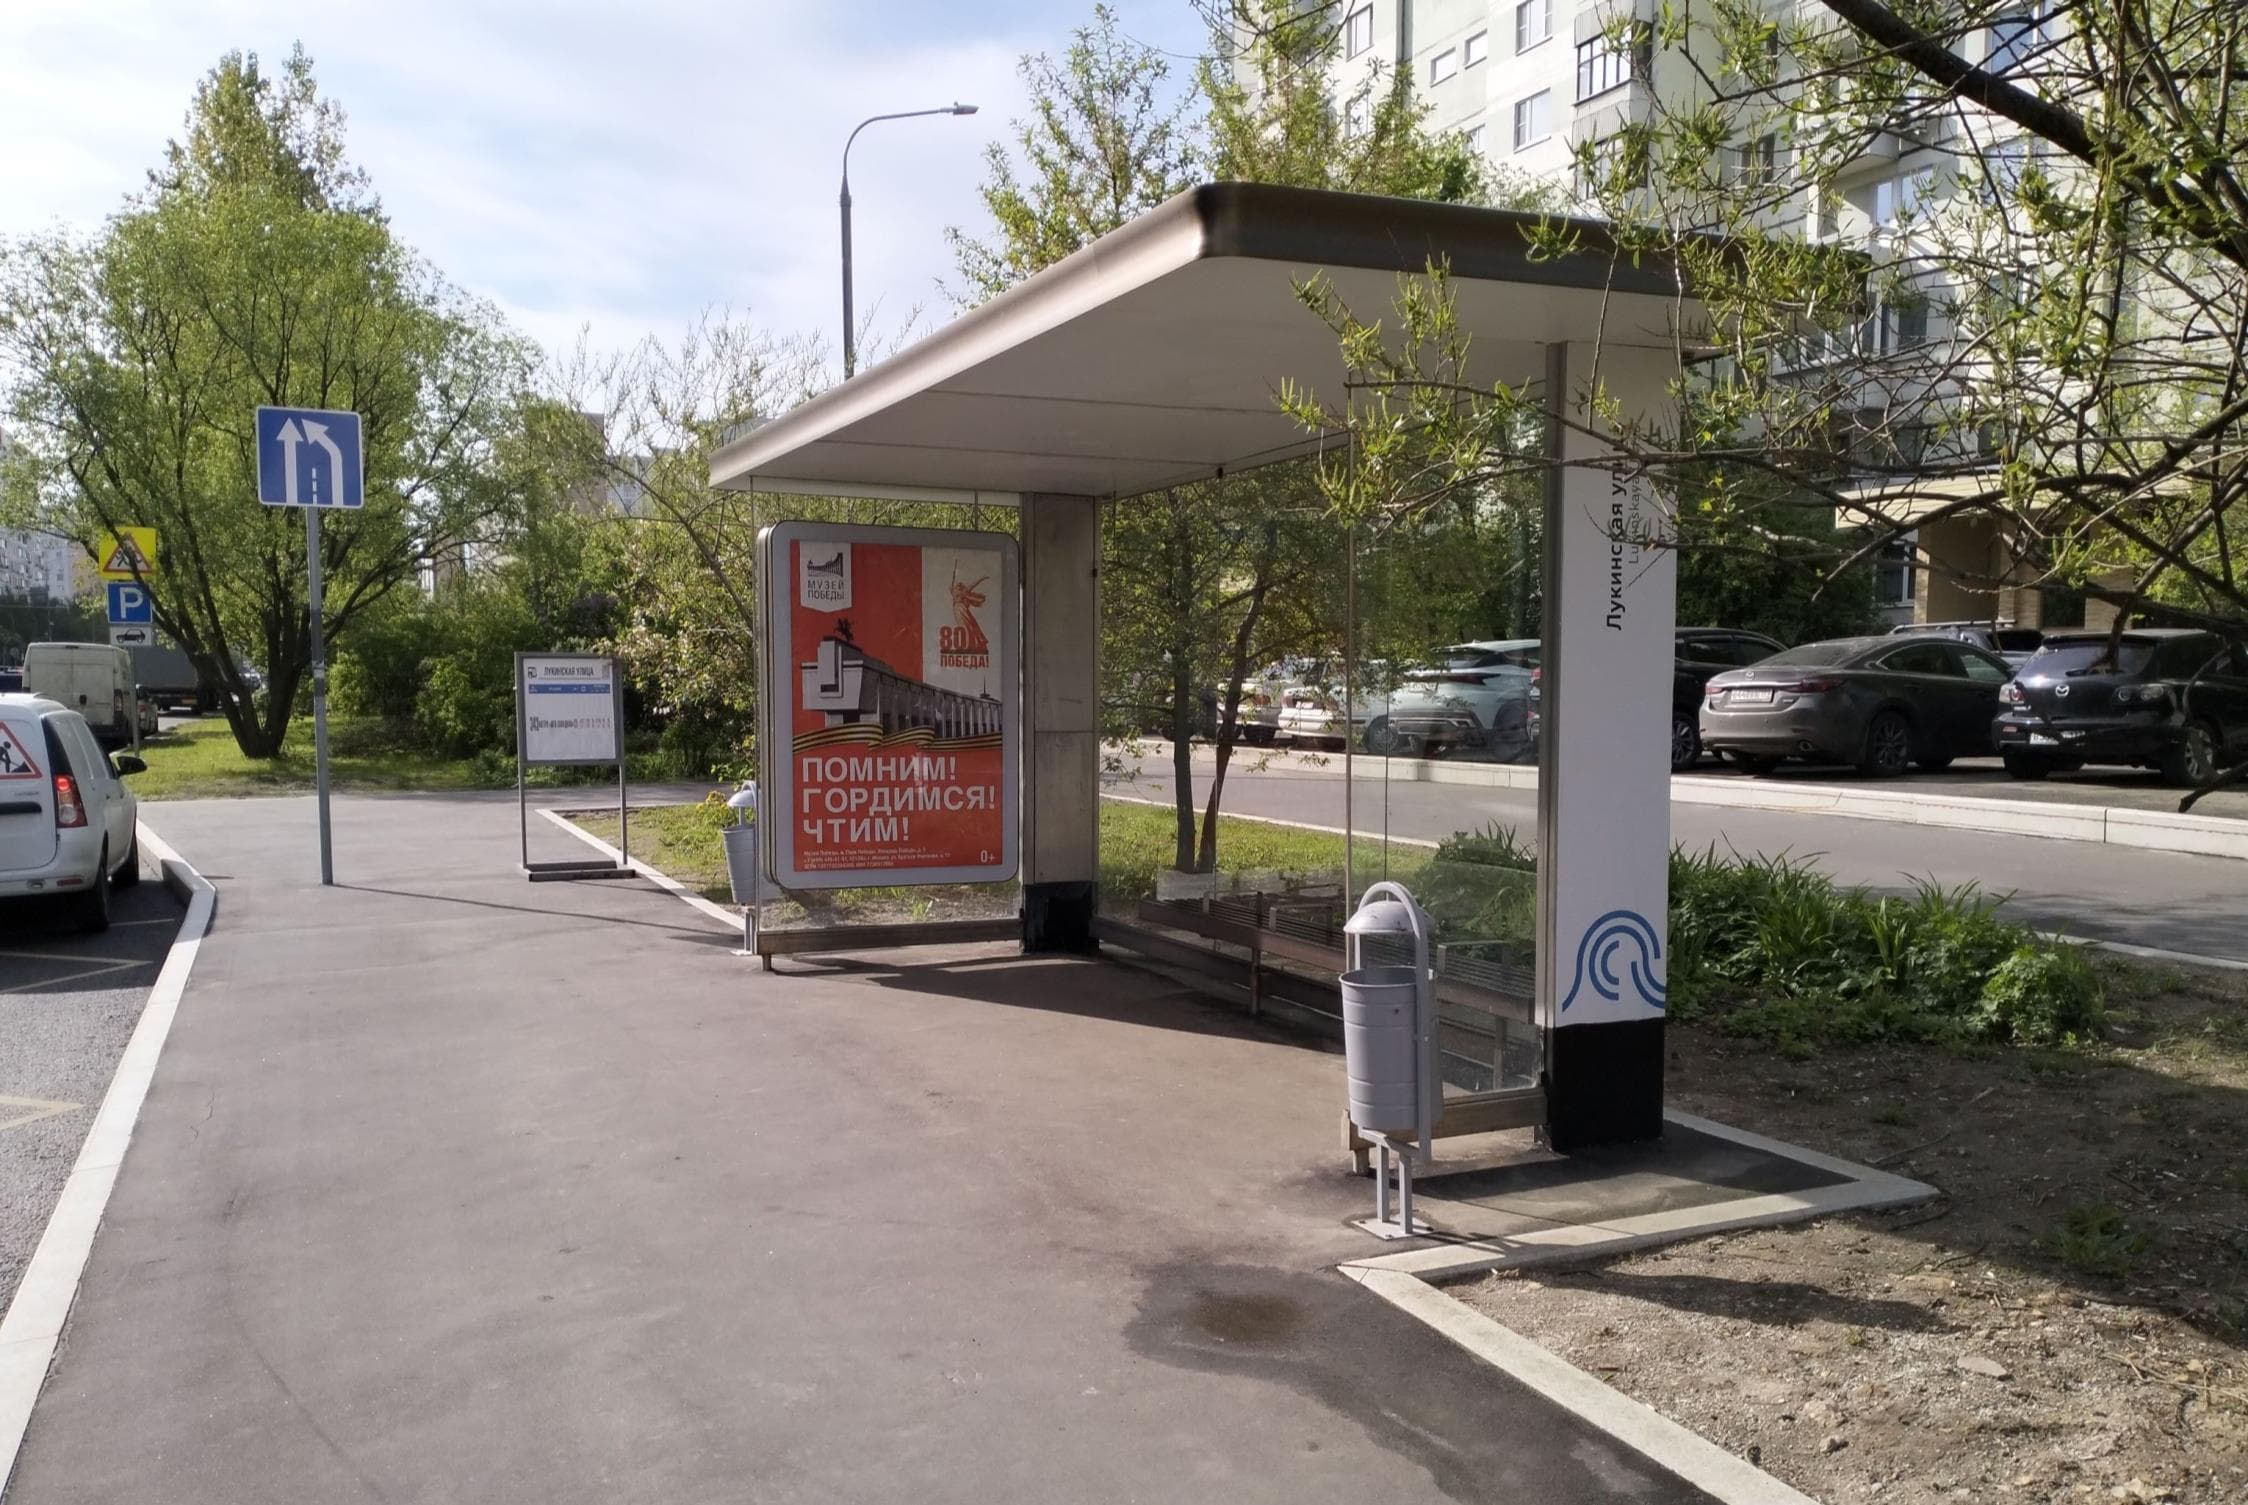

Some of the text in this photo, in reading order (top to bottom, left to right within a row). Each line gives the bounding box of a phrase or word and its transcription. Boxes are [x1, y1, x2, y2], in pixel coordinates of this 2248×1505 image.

[1606, 502, 1626, 631] Лукинская
[807, 579, 845, 590] МУЗЕЙ
[807, 590, 845, 601] ПОБЕДЫ
[119, 586, 144, 619] P
[939, 625, 967, 650] 80
[939, 654, 990, 669] ПОБЕДА!
[802, 755, 957, 783] ПОМНИМ!
[802, 786, 996, 817] ГОРДИМСЯ!
[802, 816, 910, 844] ЧТИМ!
[979, 849, 996, 864] 0+
